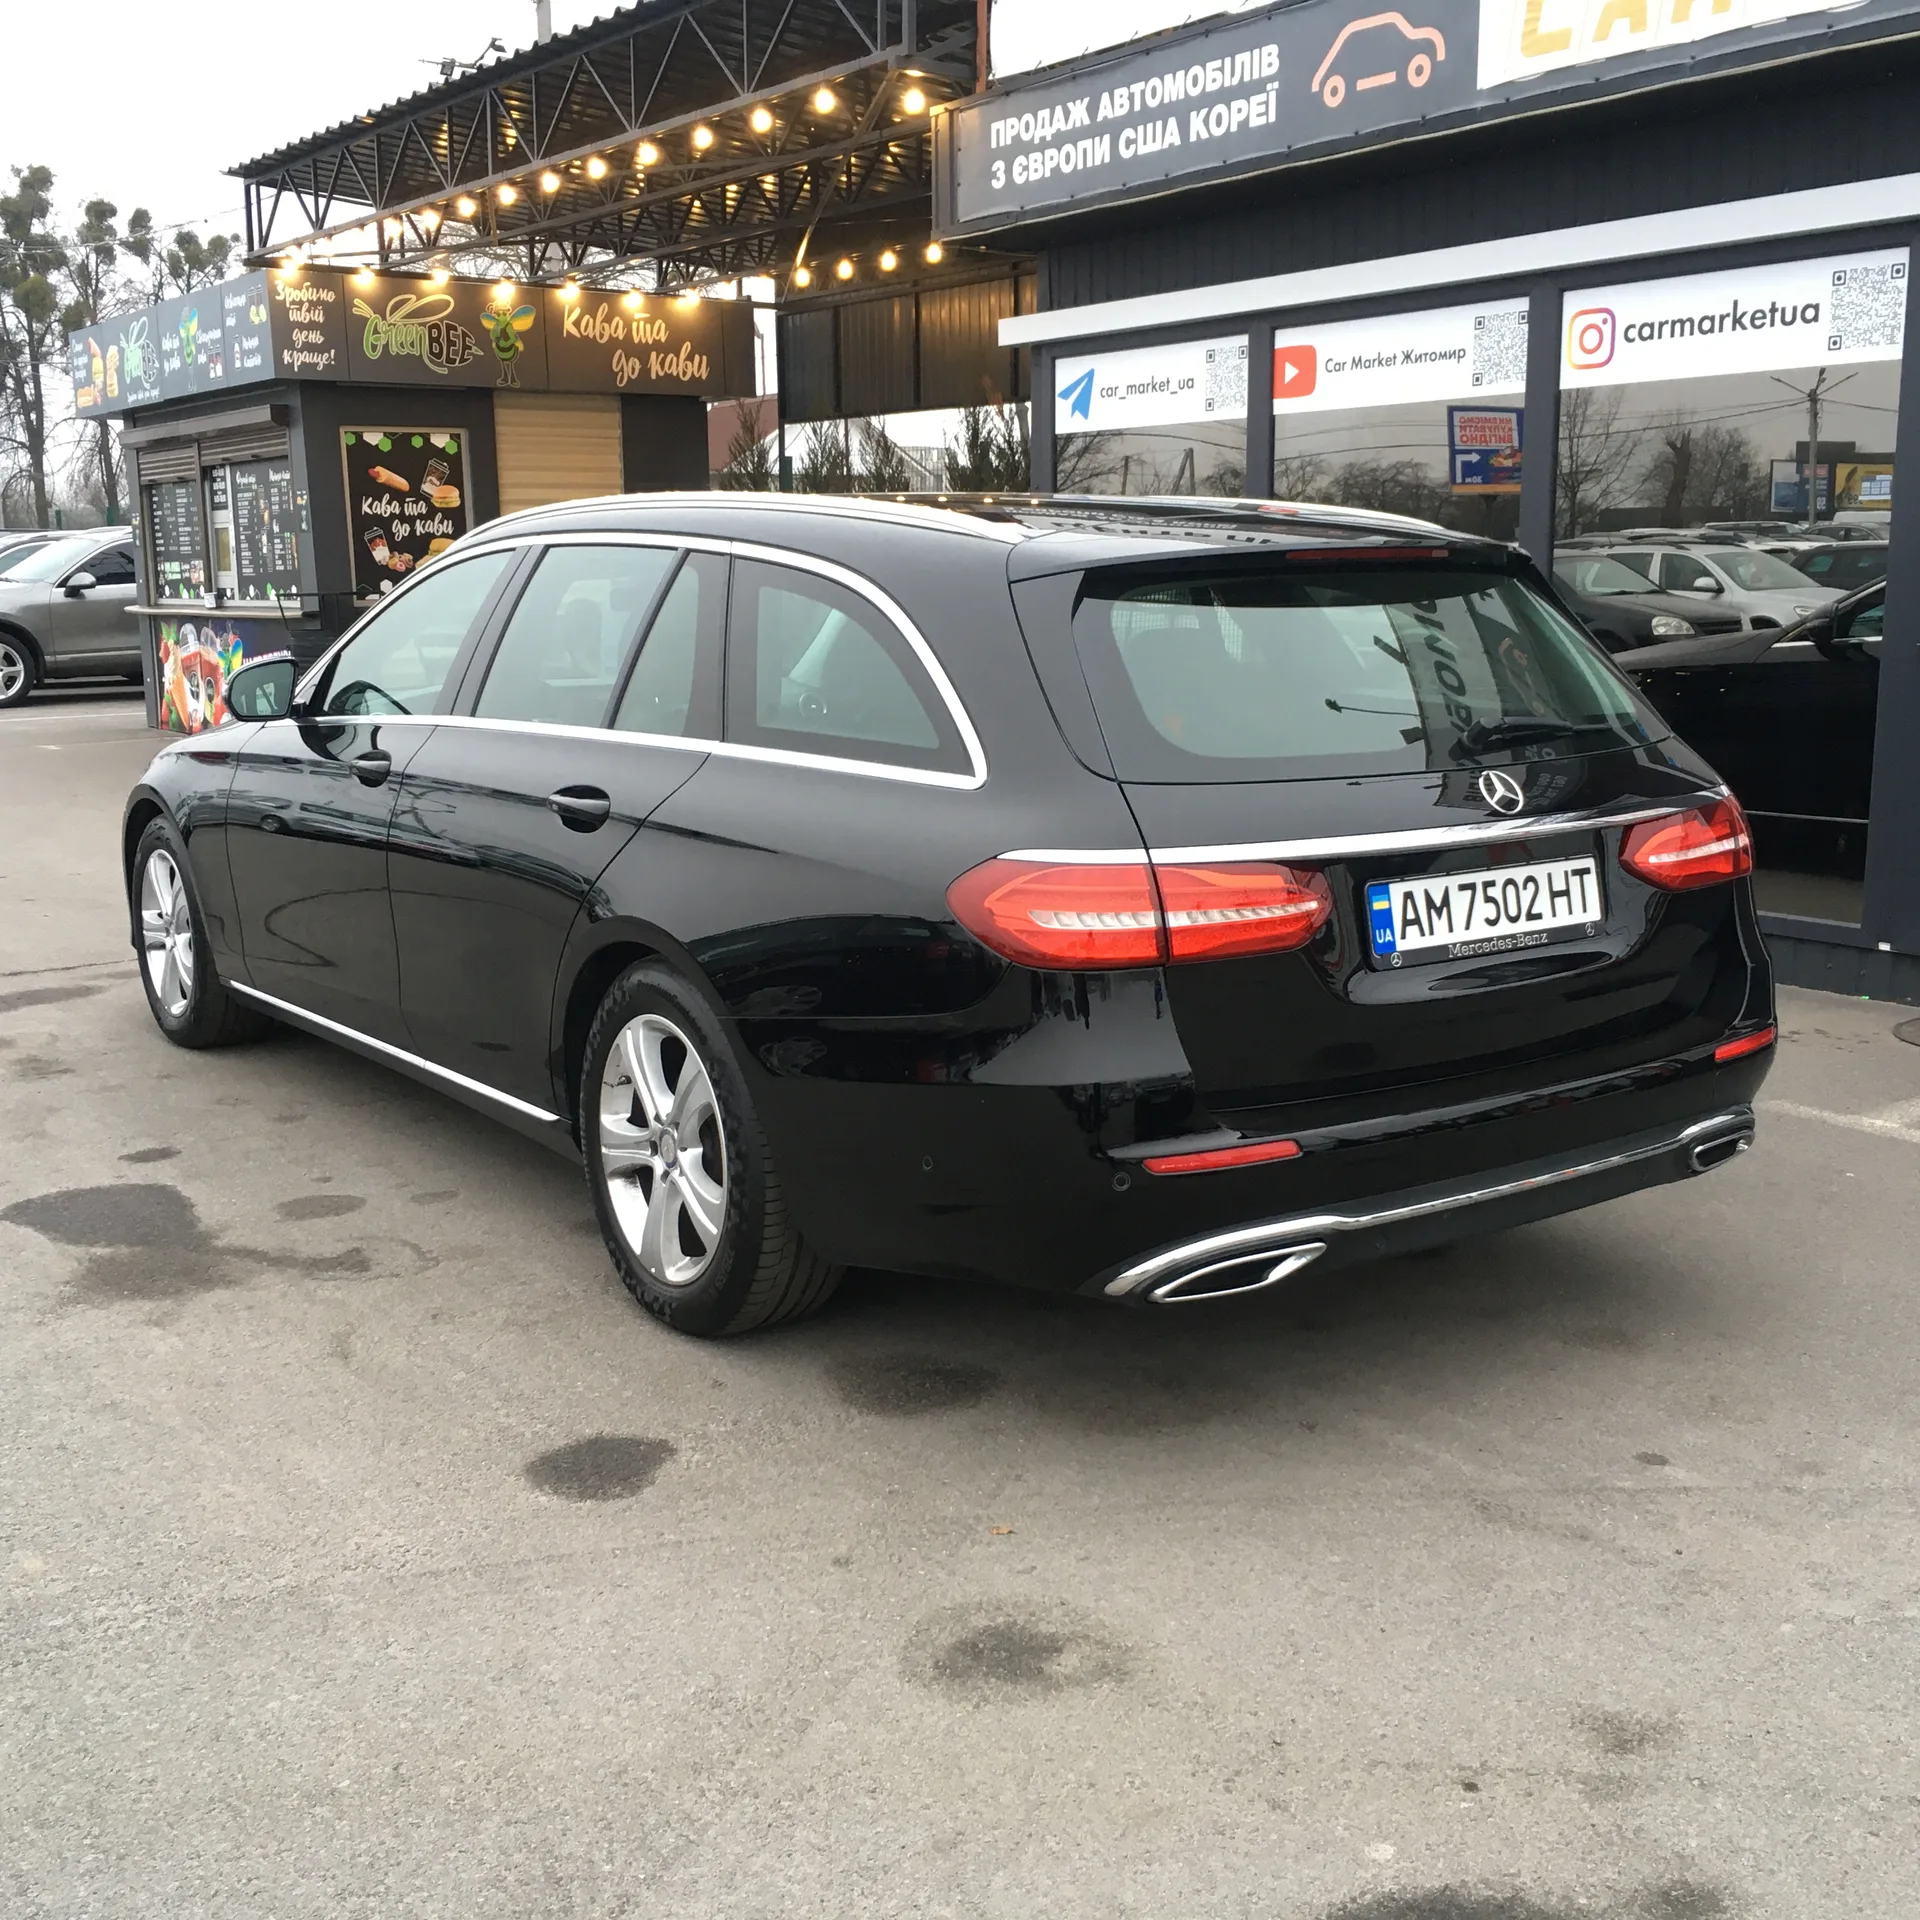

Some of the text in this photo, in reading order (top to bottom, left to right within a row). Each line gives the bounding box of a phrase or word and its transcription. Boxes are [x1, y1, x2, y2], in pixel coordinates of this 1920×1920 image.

[990, 43, 1280, 149] ПРОДАЖ АВТОМОБІЛІВ
[990, 82, 1279, 190] З ЄВРОПИ США КОРЕЇ
[275, 279, 336, 307] Зробимо
[289, 303, 325, 324] твій
[563, 302, 669, 345] Кава та
[1623, 299, 1821, 344] carmarketua
[292, 328, 325, 349] день
[282, 349, 336, 372] краще!
[612, 341, 711, 387] до кави
[1324, 346, 1466, 374] Car Market Житомир
[1100, 374, 1195, 402] car_market_ua
[361, 493, 428, 517] Кава та
[392, 512, 455, 541] до кави
[1375, 929, 1394, 943] UA
[1448, 931, 1548, 958] Mercedes-Benz
